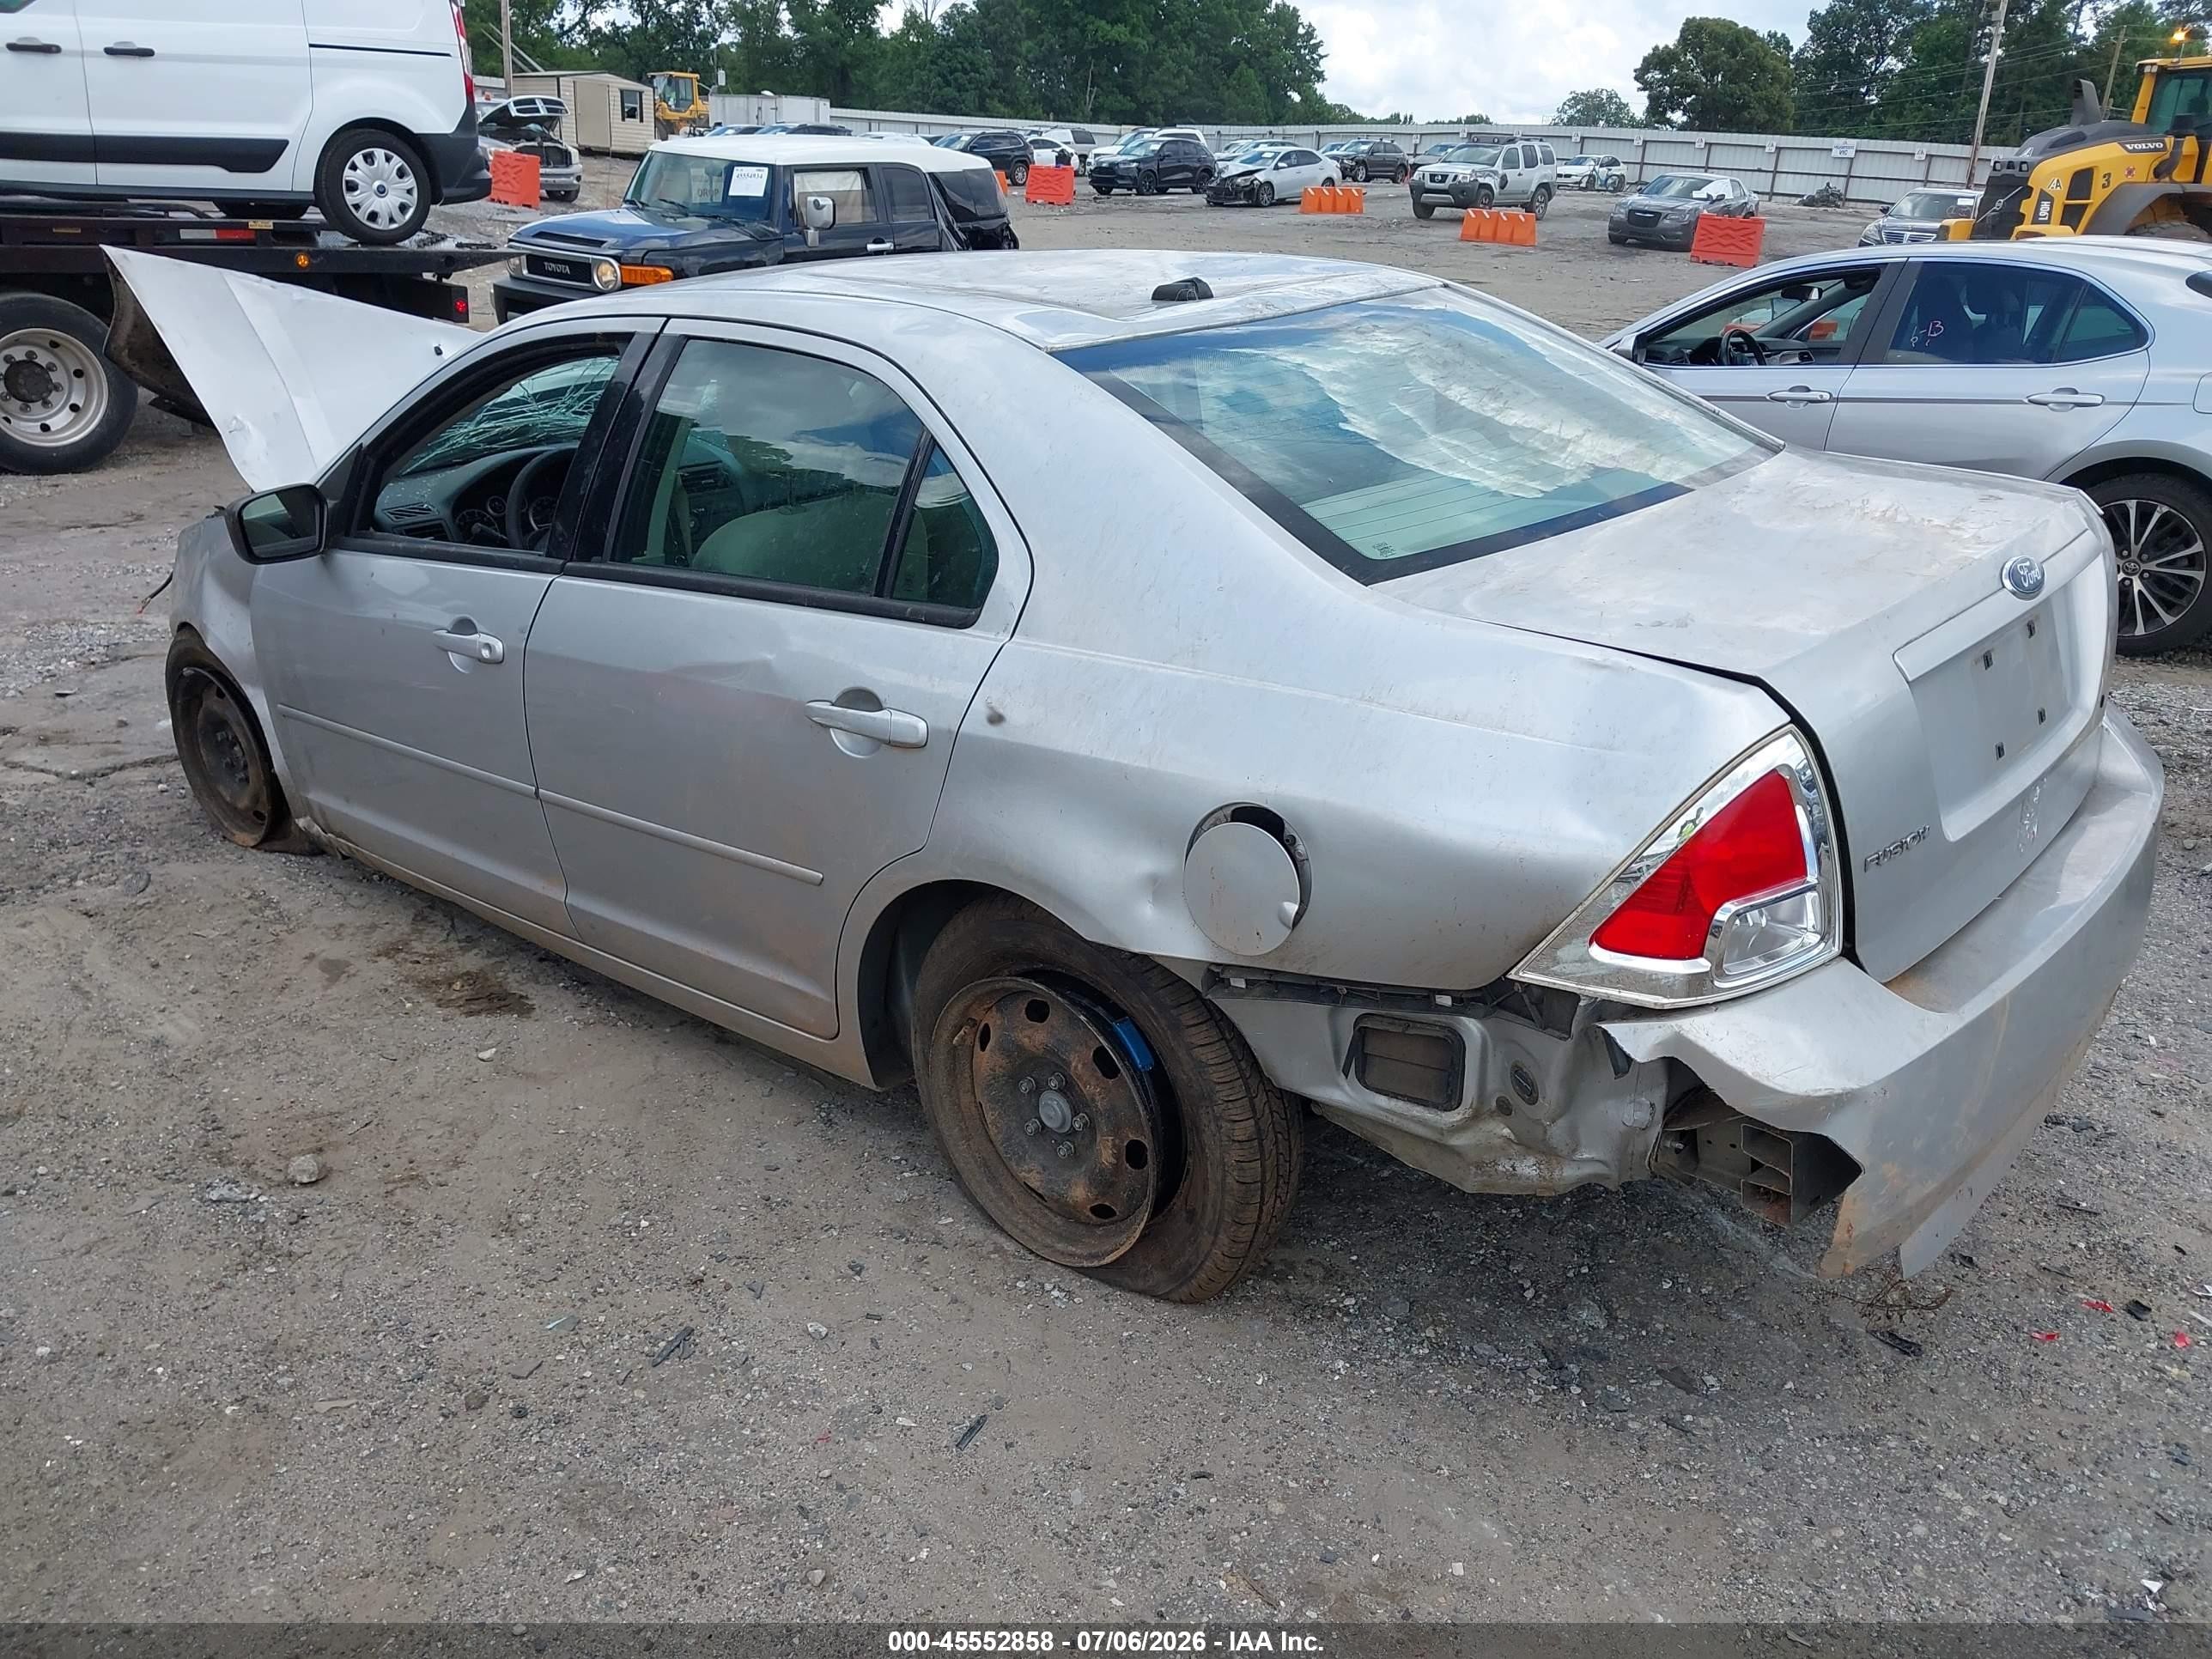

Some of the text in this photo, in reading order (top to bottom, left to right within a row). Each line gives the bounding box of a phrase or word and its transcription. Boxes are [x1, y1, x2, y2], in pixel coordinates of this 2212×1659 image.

[2124, 142, 2165, 150] VOLVO
[2101, 172, 2112, 189] 3
[2038, 201, 2051, 221] L90H
[543, 261, 571, 275] TOYOTA
[2016, 561, 2042, 587] Ford
